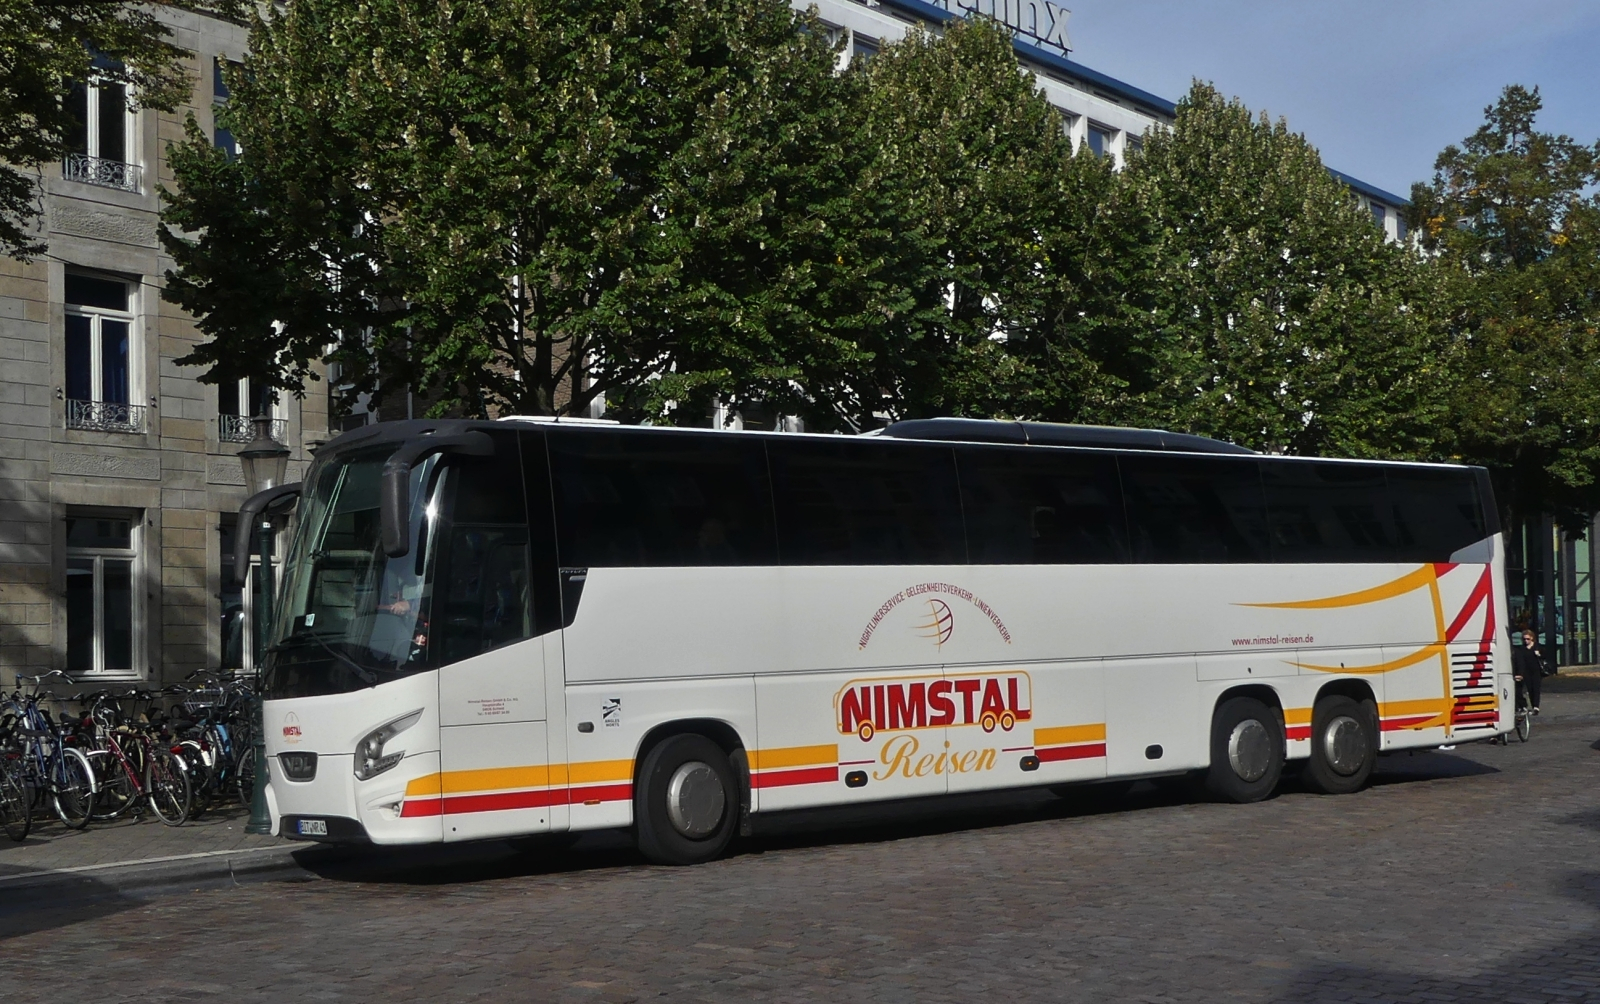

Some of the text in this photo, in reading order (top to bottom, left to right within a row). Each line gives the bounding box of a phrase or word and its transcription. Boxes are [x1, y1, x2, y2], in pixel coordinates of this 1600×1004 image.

[859, 582, 1011, 648] NIGHTLINERSERVICE GELEGENHEITSVERKEHR LINIENVERKEHR
[1231, 633, 1314, 646] www.nimstal-reisen.de
[841, 677, 1031, 733] NIMSTAL
[872, 734, 998, 781] Reisen
